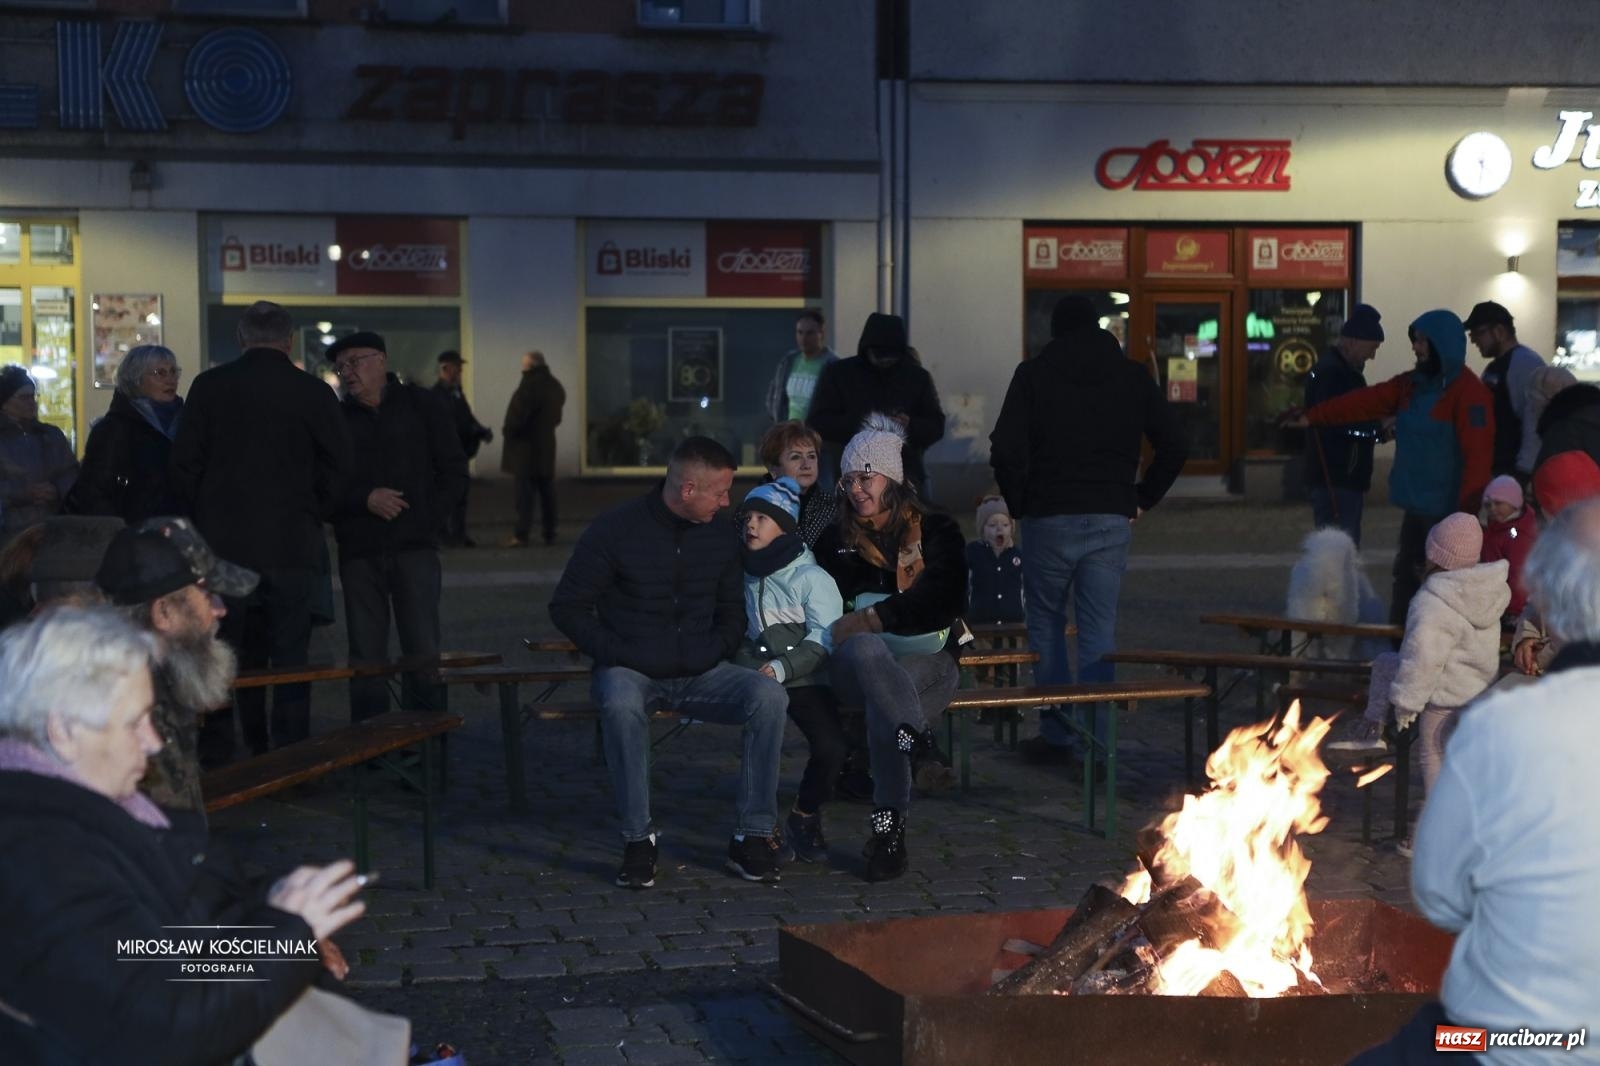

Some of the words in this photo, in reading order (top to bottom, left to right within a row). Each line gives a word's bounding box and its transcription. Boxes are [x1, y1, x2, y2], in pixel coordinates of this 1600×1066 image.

[340, 64, 766, 140] zaprasza
[249, 243, 321, 267] Bliski
[625, 248, 691, 270] Bliski
